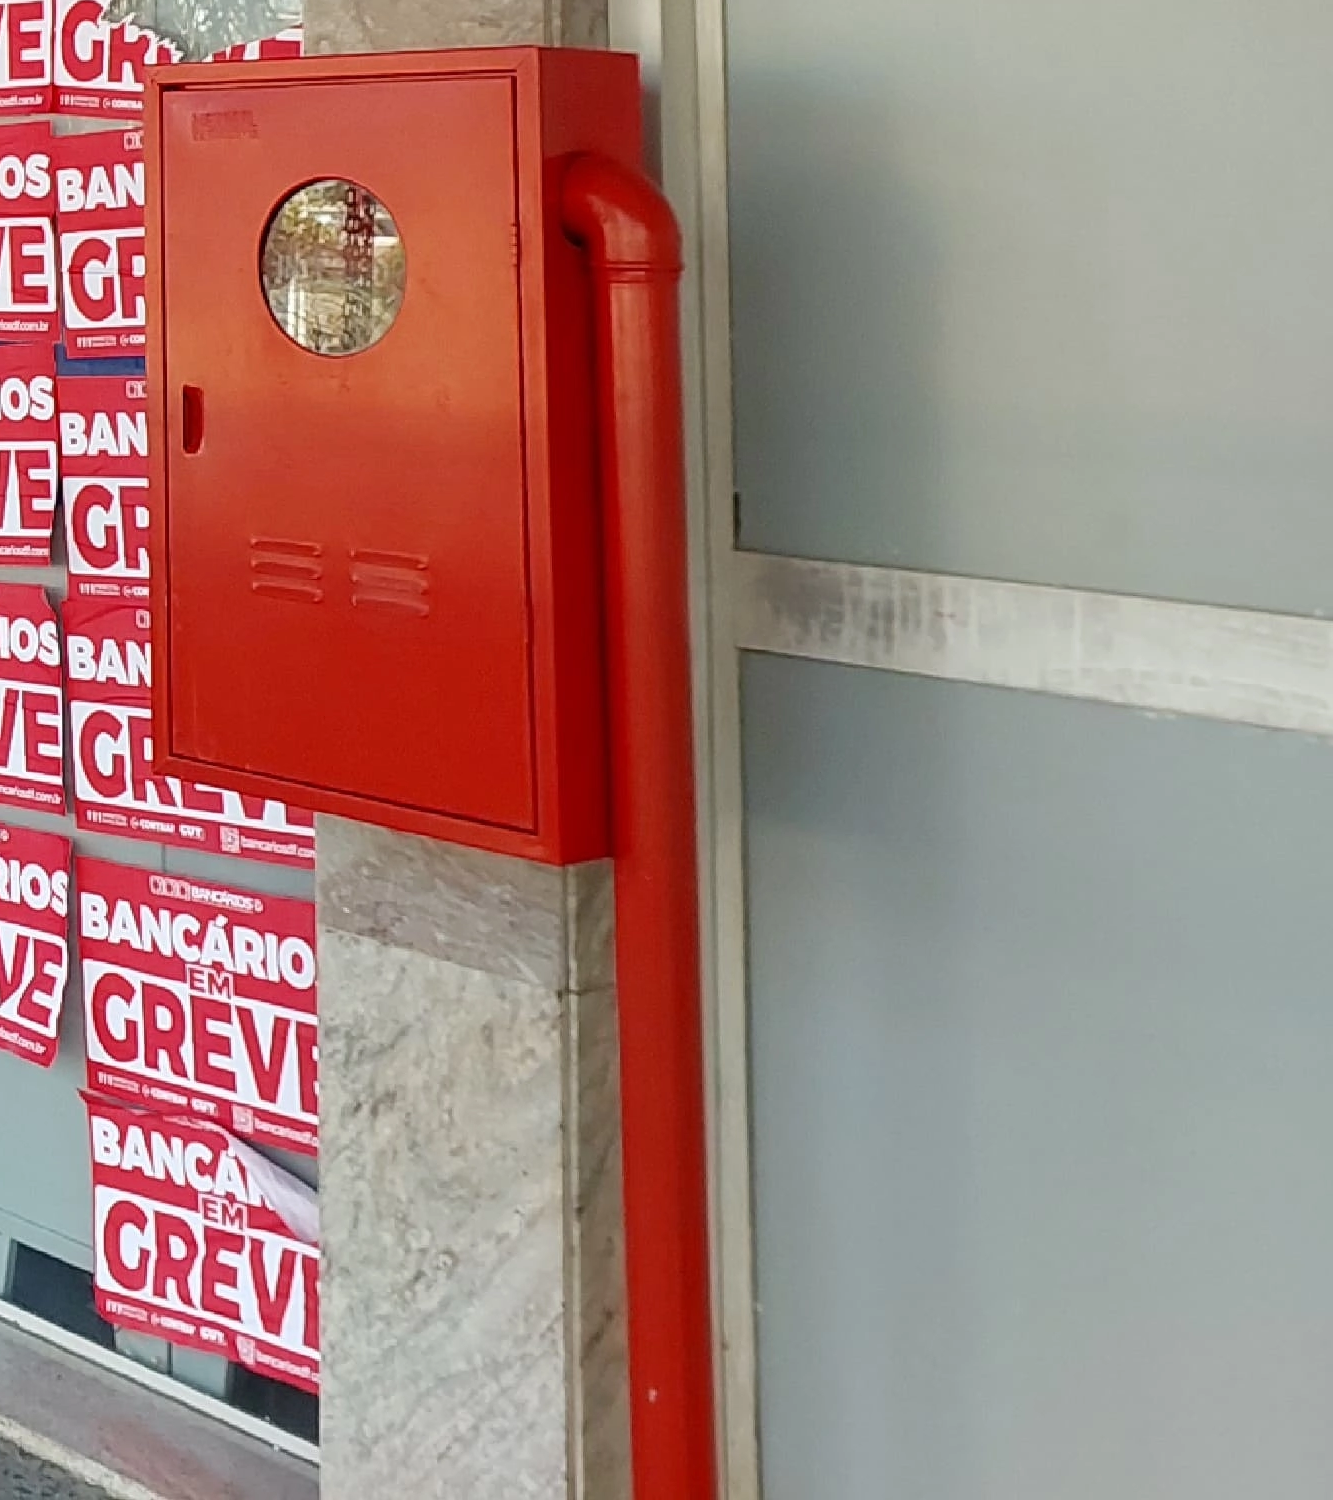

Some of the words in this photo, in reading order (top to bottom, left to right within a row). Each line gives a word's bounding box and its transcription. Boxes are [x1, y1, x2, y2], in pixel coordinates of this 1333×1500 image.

[82, 891, 315, 989] BANCÁRIO
[189, 970, 233, 997] EM
[203, 1199, 245, 1228] EM
